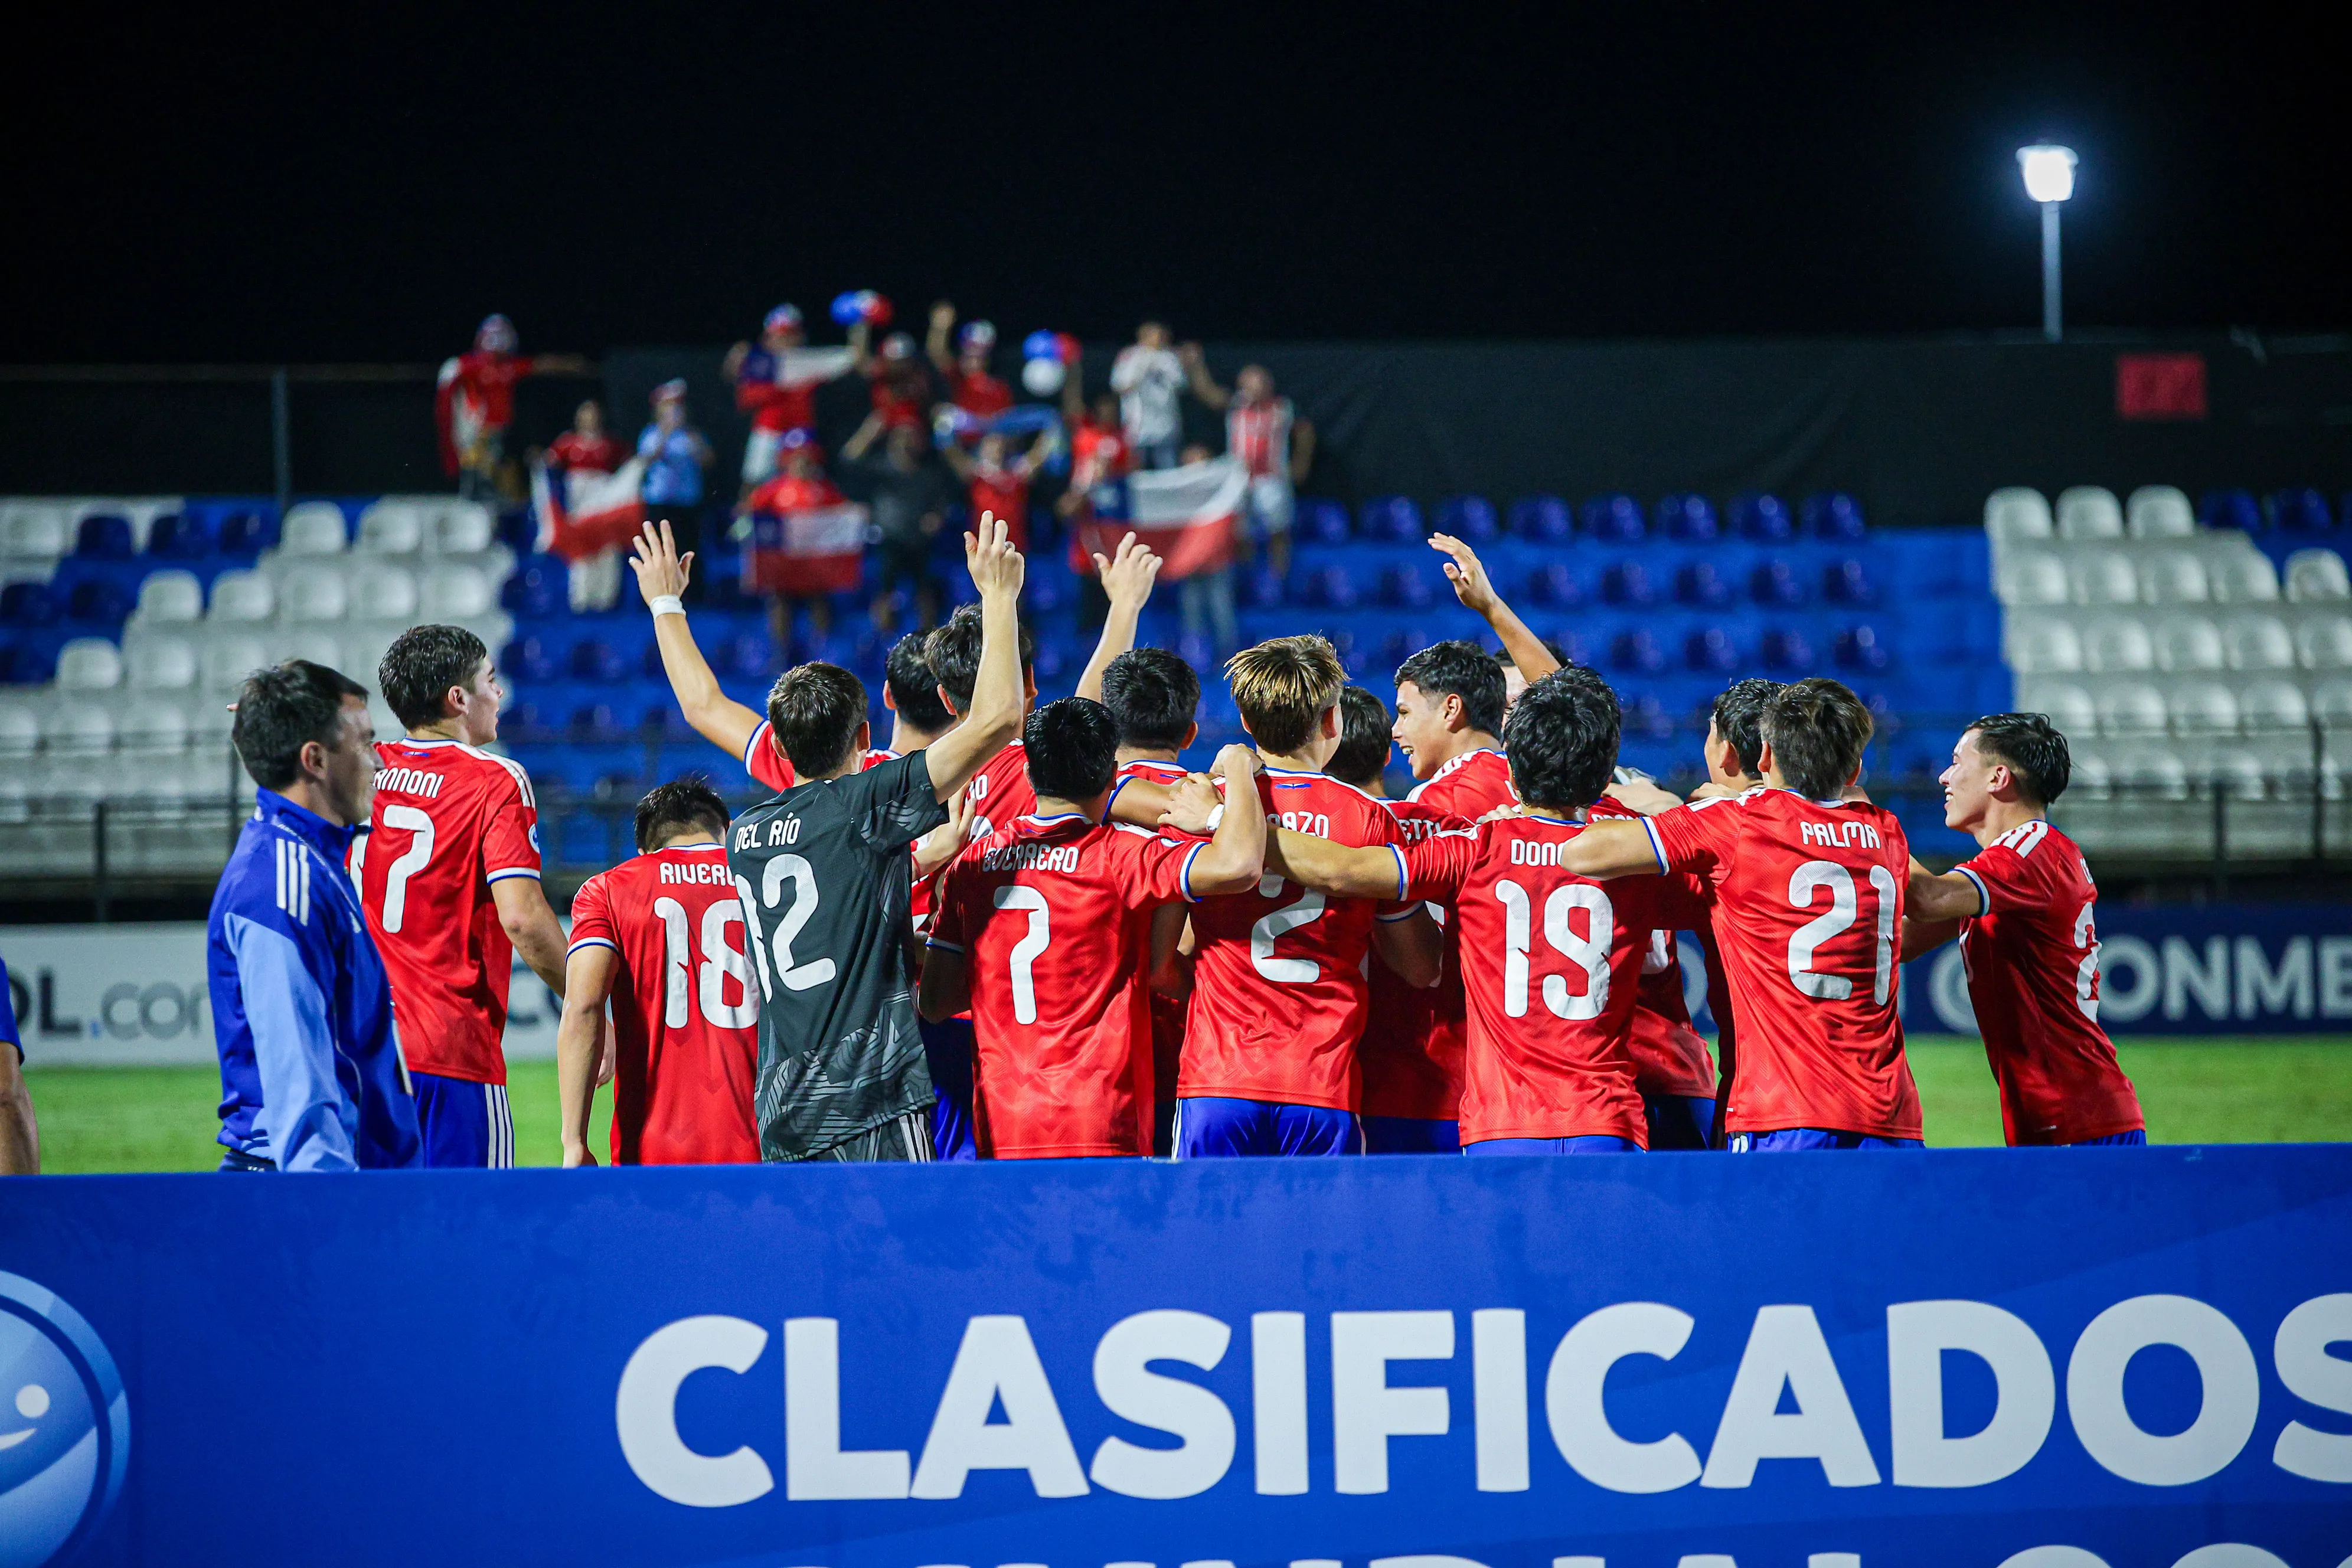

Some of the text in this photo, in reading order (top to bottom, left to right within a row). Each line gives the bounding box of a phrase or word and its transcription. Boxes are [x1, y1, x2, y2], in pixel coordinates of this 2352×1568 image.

[734, 811, 801, 854] DEL RÍO
[982, 842, 1080, 874] GUERRERO
[1800, 821, 1881, 849] PALMA
[653, 896, 760, 1029] 18
[993, 885, 1050, 1025] 7
[1251, 867, 1326, 983] 2
[1494, 878, 1614, 1021] 19
[1788, 860, 1897, 1006] 21
[616, 1293, 2352, 1508] CLASIFICADOS
